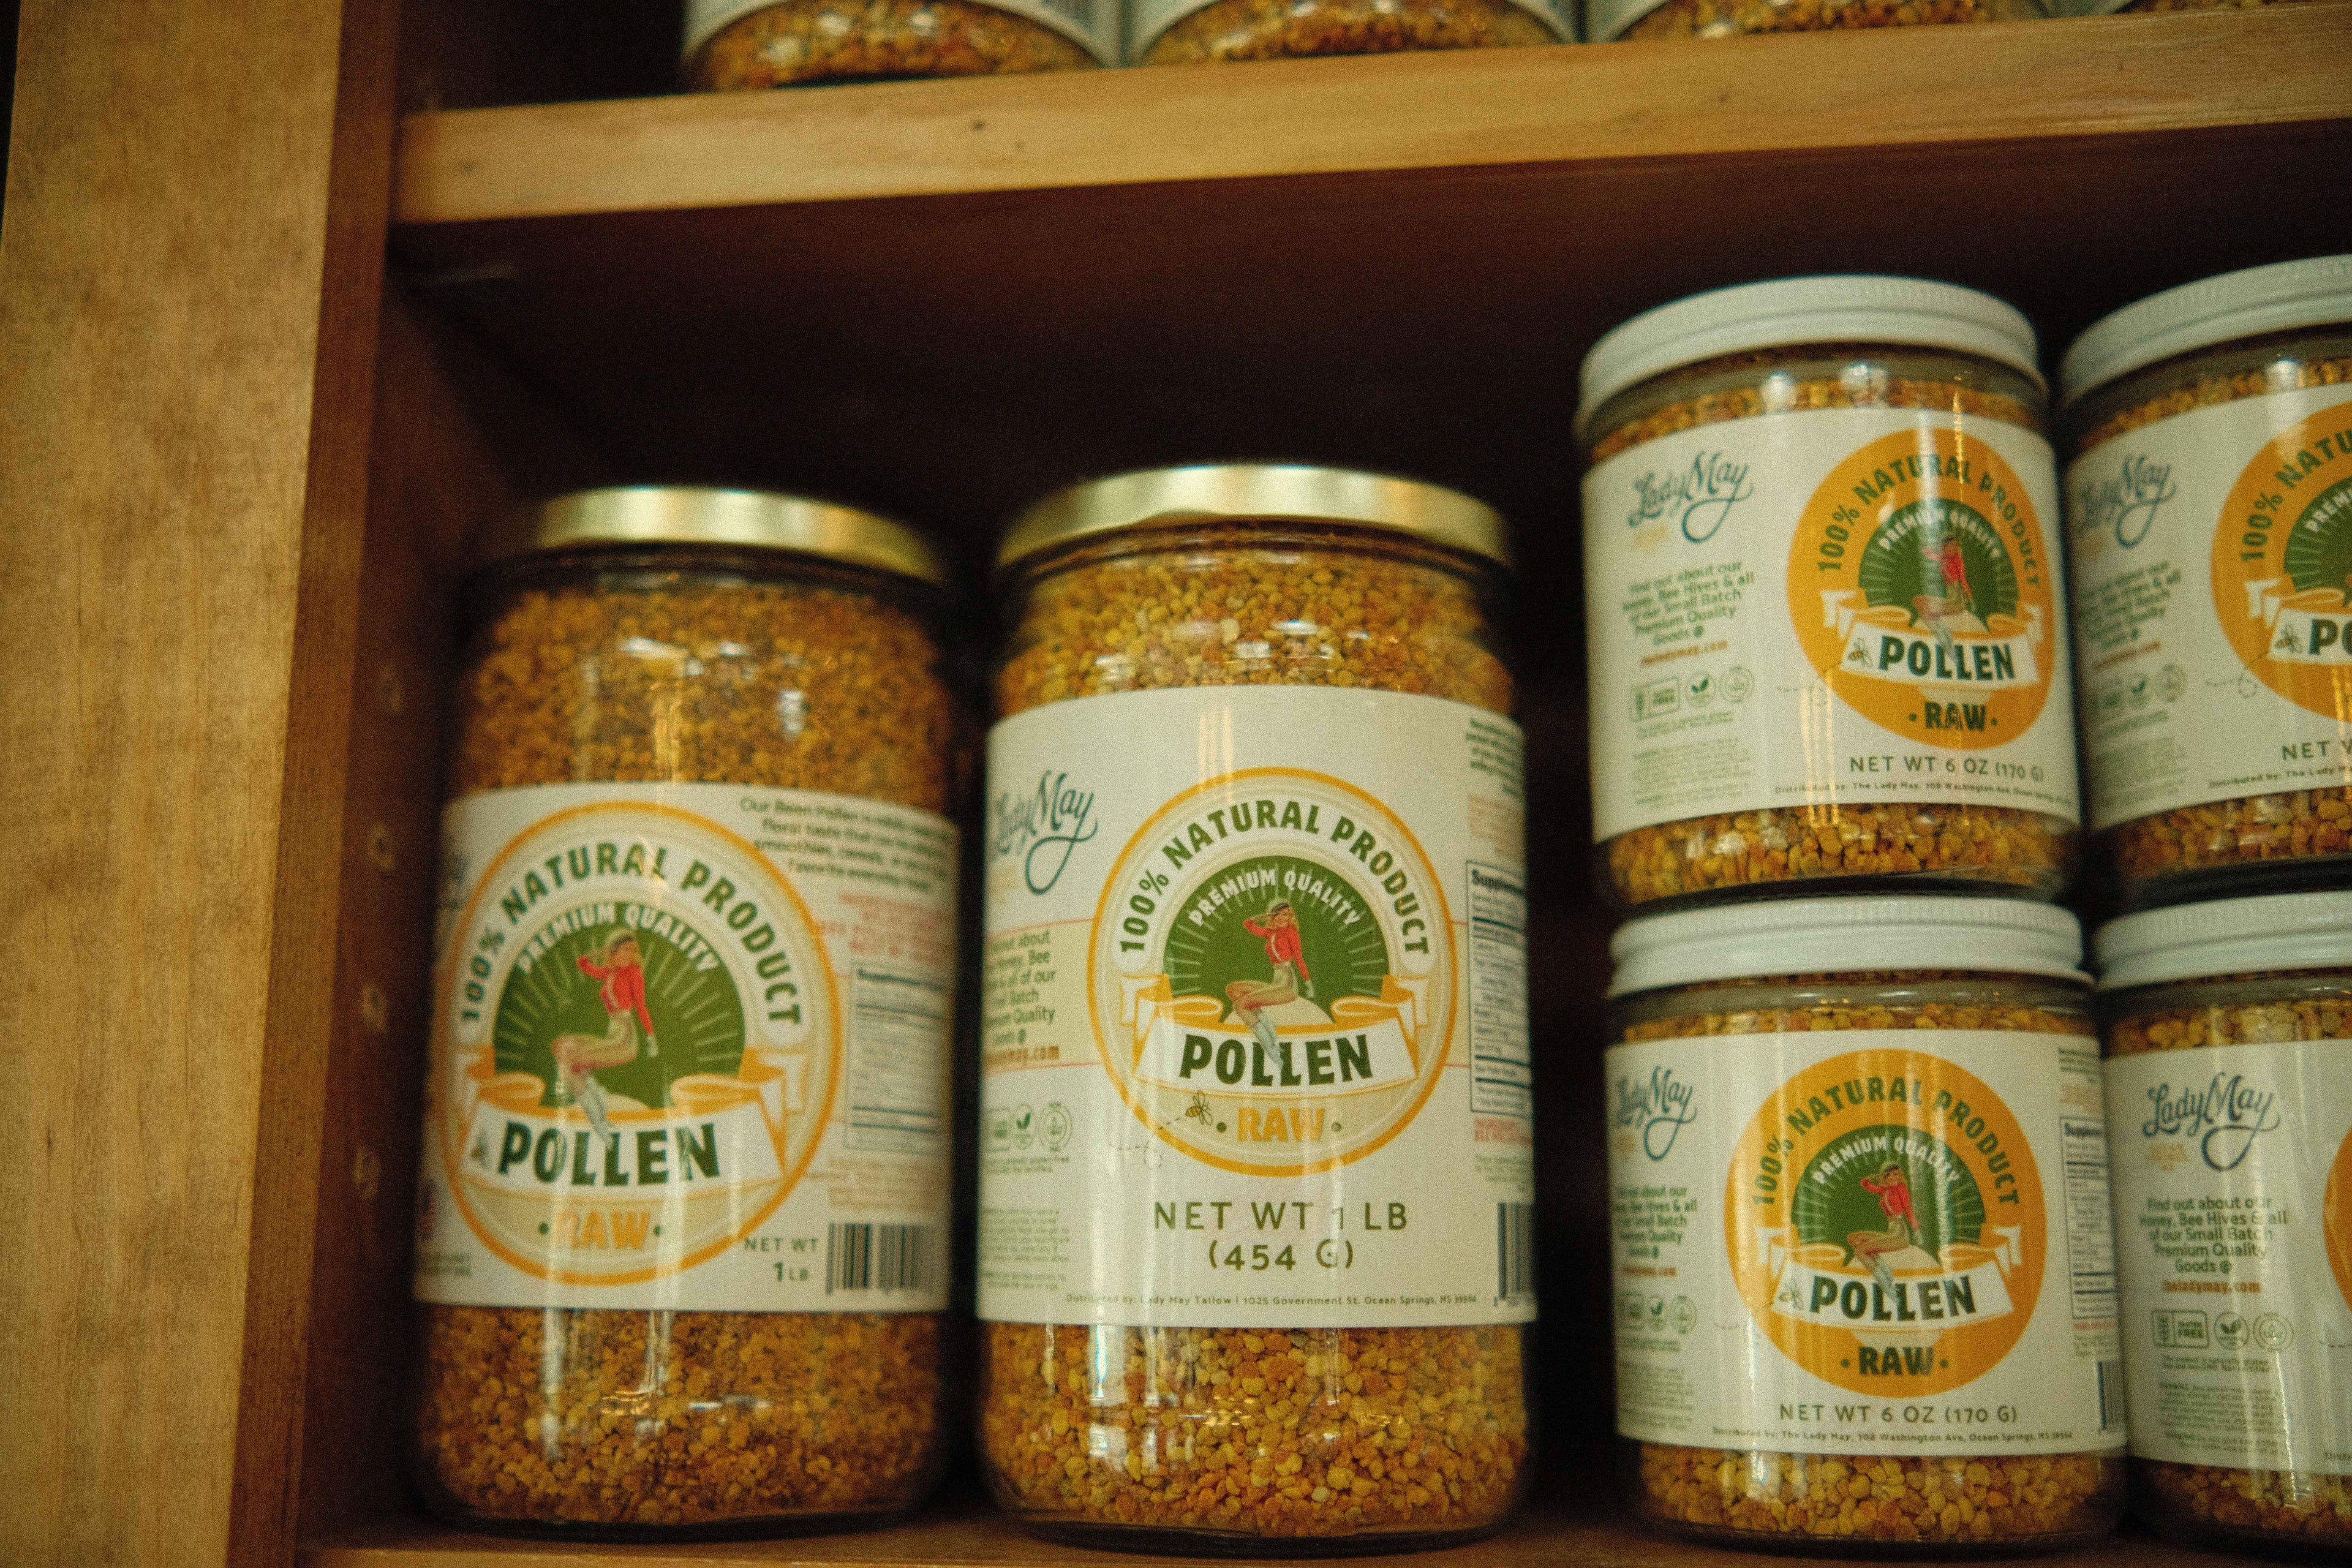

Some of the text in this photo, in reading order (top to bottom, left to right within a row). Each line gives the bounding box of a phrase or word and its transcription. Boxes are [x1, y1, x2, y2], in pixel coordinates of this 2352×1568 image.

[2240, 428, 2352, 562] 100% NATU
[1818, 504, 1860, 573] 100%
[1853, 453, 1972, 505] NATURAL
[1978, 472, 2040, 588] PRODUCT
[1878, 635, 2016, 680] POLLEN
[1924, 701, 1986, 732] RAW
[1850, 756, 1894, 773] NET
[1904, 756, 1937, 772] WT
[1945, 758, 1956, 772] 6
[1963, 757, 1989, 775] OZ
[2281, 740, 2330, 760] NET
[1120, 869, 1170, 954] 100%
[1161, 799, 1321, 871] NATURAL
[1329, 815, 1430, 955] PRODUCT
[1188, 869, 1363, 927] PREMIUM QUALITY
[462, 933, 504, 1022] 100%
[501, 842, 668, 924] NATURAL
[680, 860, 802, 1026] PRODUCT
[516, 902, 720, 975] PREMIUM QUALITY
[1178, 1033, 1374, 1088] POLLEN
[1237, 1107, 1325, 1142] RAW
[2144, 1071, 2281, 1172] Lady May
[497, 1121, 721, 1187] POLLEN
[1752, 1076, 2019, 1206] 100% NATURAL PRODUCT
[1812, 1135, 1959, 1185] PREMIUM QUALITY
[1153, 1201, 1232, 1230] NET
[1250, 1201, 1313, 1230] WT
[1365, 1202, 1408, 1231] LB
[2173, 1197, 2195, 1211] out
[2198, 1196, 2241, 1210] about
[2245, 1197, 2272, 1210] or
[2179, 1212, 2204, 1226] Bee
[2207, 1211, 2247, 1226] Hives
[2268, 1210, 2288, 1225] all
[554, 1210, 650, 1250] RAW
[744, 1237, 818, 1254] NET WT
[2185, 1227, 2224, 1241] Small
[1208, 1239, 1297, 1271] (454
[2154, 1242, 2268, 1260] Premium Quality
[2174, 1259, 2233, 1275] Goods @
[1243, 1297, 1269, 1305] 1025
[1272, 1295, 1343, 1306] Government
[1364, 1295, 1396, 1305] Ocean
[1809, 1275, 1977, 1322] POLLEN
[1858, 1347, 1934, 1377] RAW
[1779, 1404, 2018, 1424] NET WT 6 OZ (170 G)
[1880, 1433, 1941, 1444] Washington
[1969, 1433, 1999, 1442] Ocean
